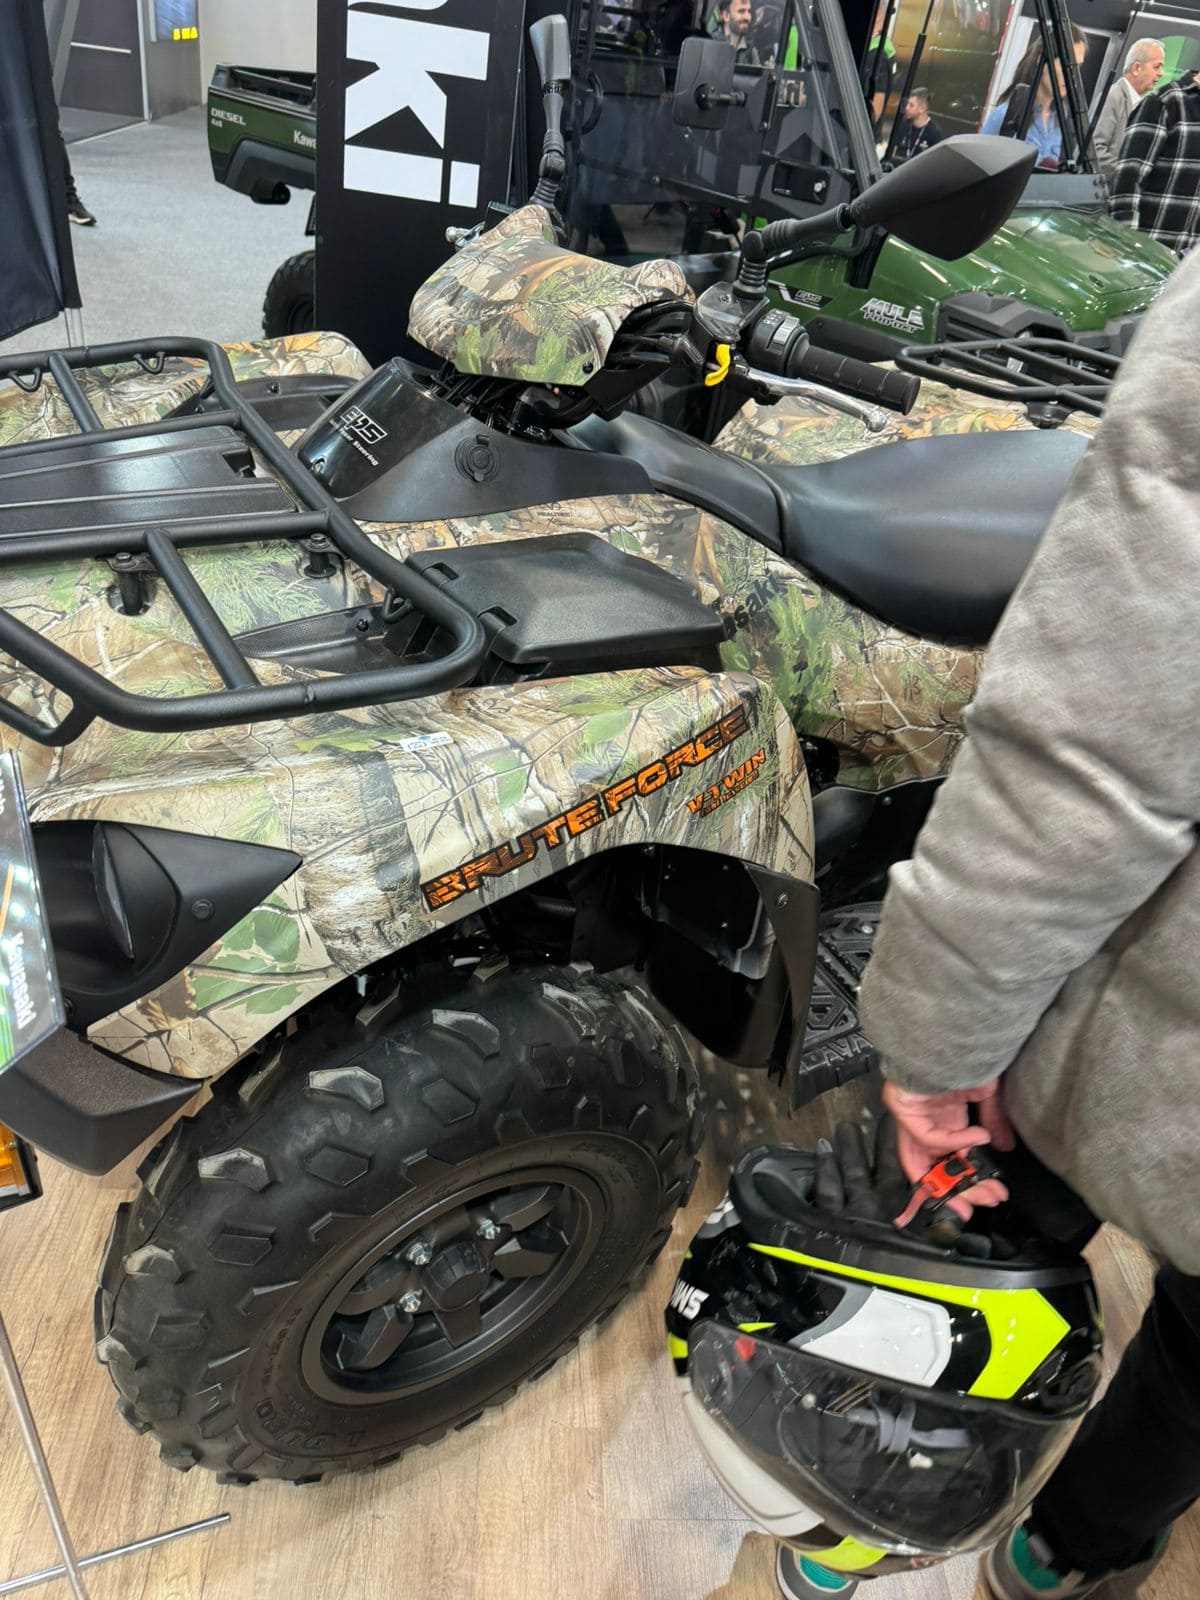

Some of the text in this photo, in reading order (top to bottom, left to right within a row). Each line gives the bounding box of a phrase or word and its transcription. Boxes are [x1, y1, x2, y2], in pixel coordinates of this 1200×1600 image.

[211, 107, 246, 126] DIESEL
[860, 297, 925, 330] MULE
[340, 404, 388, 444] EPS
[353, 440, 379, 466] Steering
[687, 746, 767, 815] V-TWIN
[419, 705, 751, 913] BRUTE FORCE
[670, 1278, 710, 1321] SM
